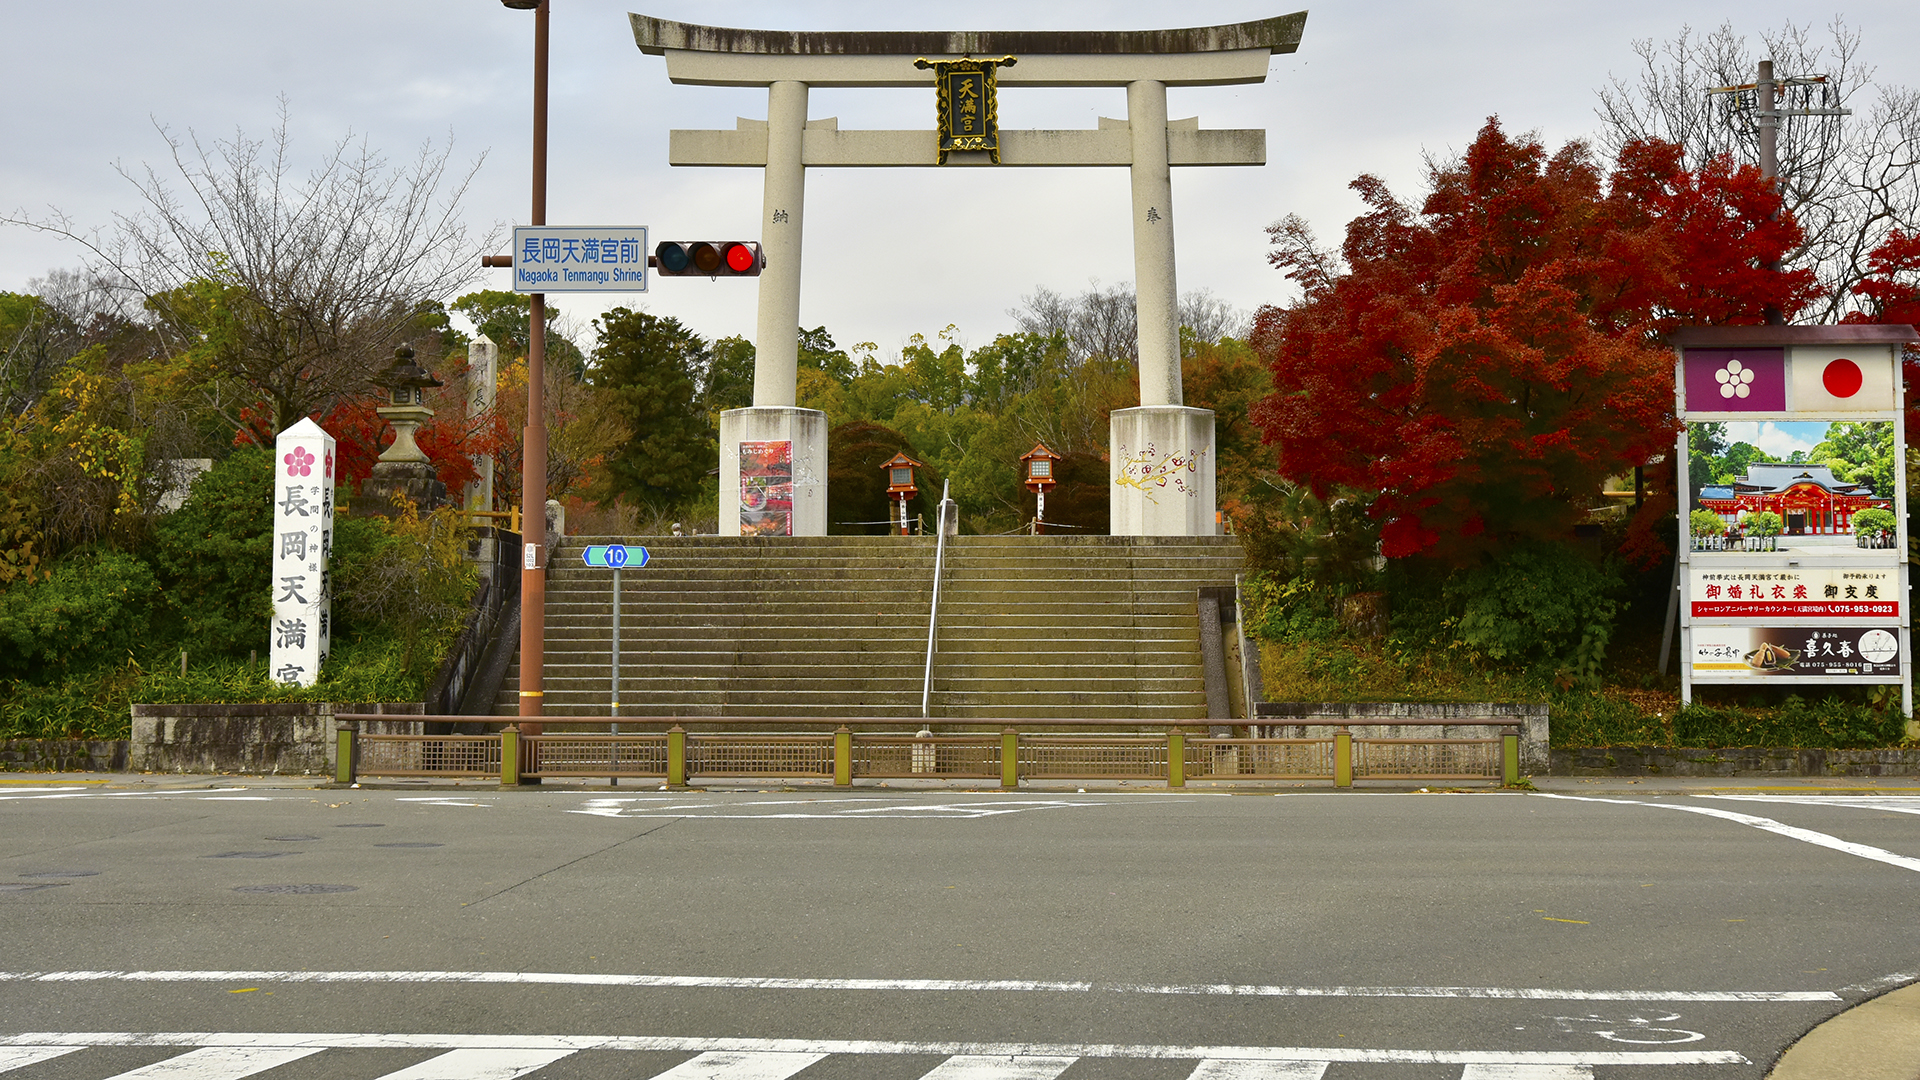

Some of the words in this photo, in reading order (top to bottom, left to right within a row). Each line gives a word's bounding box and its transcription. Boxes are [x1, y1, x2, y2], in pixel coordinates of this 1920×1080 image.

[958, 78, 979, 132] 天満宮
[772, 209, 789, 224] 納
[1146, 206, 1162, 225] 奉
[521, 237, 639, 264] 長岡天満宮前
[518, 268, 558, 285] Nagaoka
[563, 268, 609, 285] Tenmangu
[613, 267, 643, 282] Shrine
[308, 486, 320, 573] 学問の神様
[607, 549, 624, 564] 10
[1705, 584, 1808, 599] 御婚礼衣裳
[1823, 584, 1879, 599] 御支度
[1835, 605, 1893, 613] 075-953-0923
[1803, 638, 1854, 658] 喜久春
